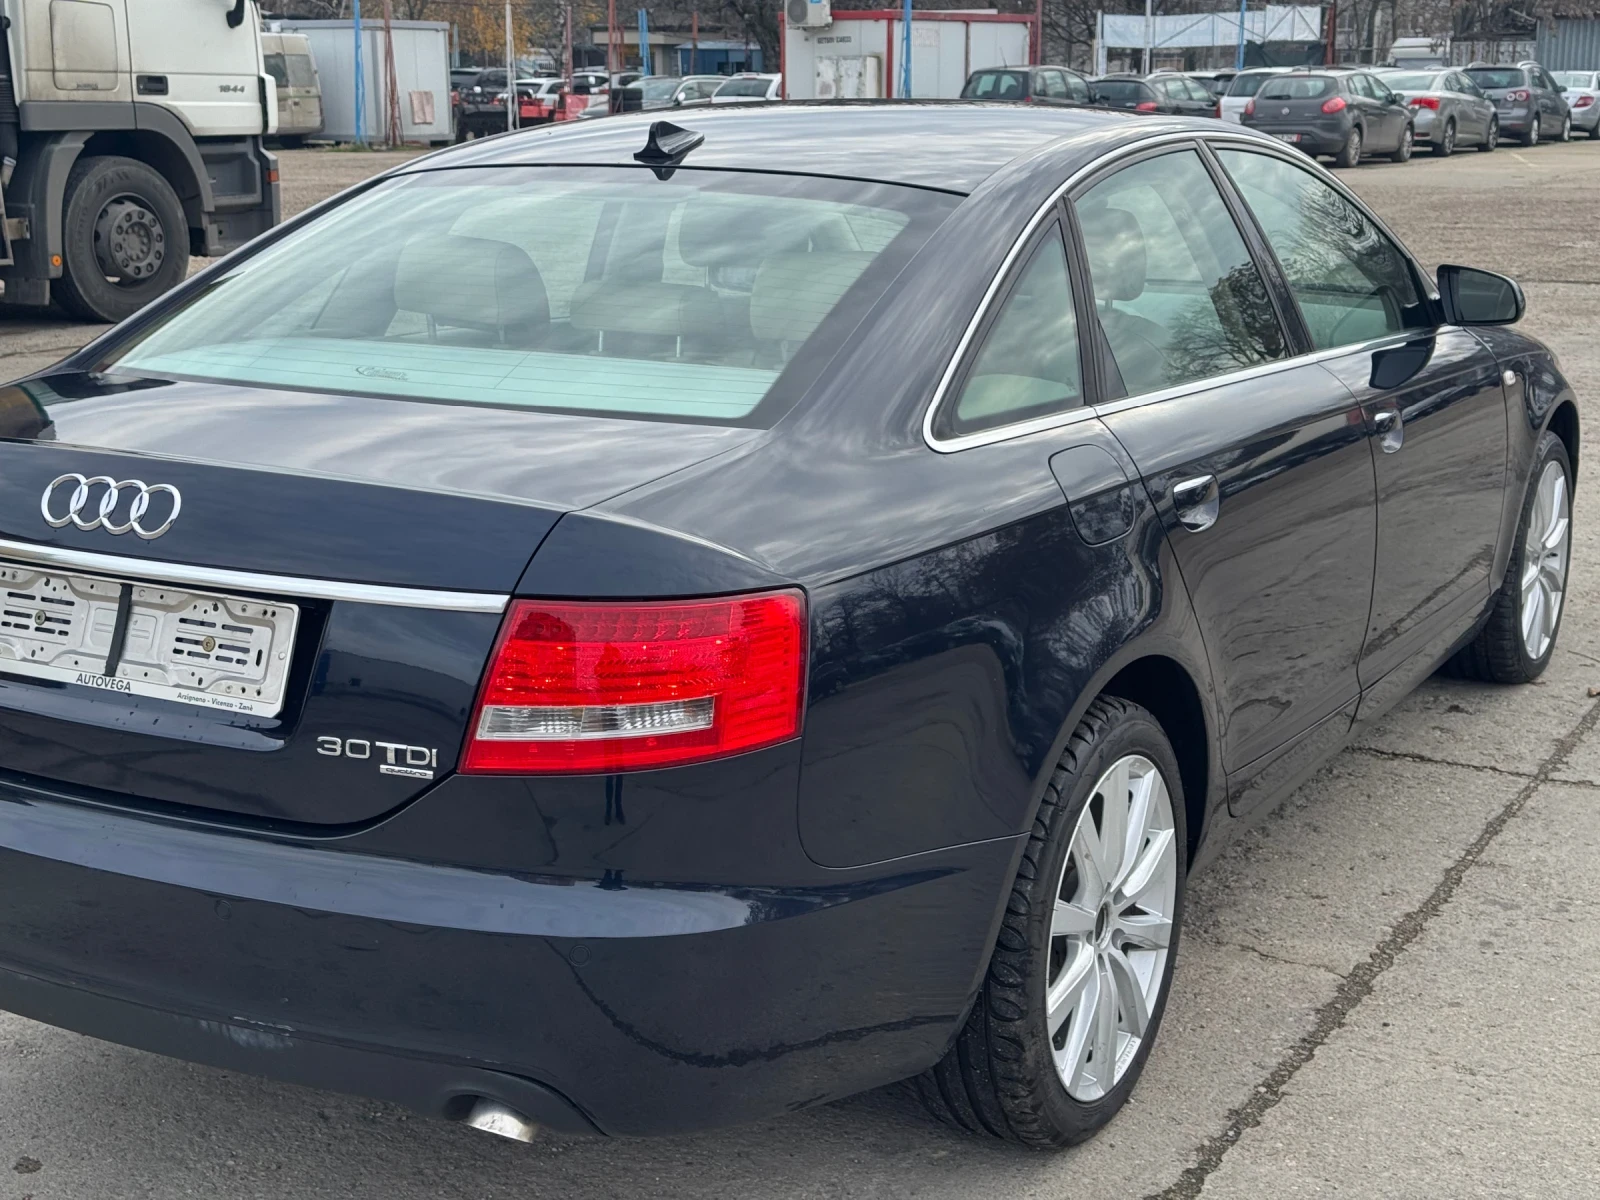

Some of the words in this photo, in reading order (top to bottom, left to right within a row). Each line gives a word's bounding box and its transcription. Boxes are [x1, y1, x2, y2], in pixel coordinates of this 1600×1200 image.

[75, 673, 131, 692] AUTOVEGA
[211, 698, 233, 708] Vicenza
[317, 736, 370, 759] 30
[376, 741, 438, 767] TDI
[385, 767, 427, 777] quattro
